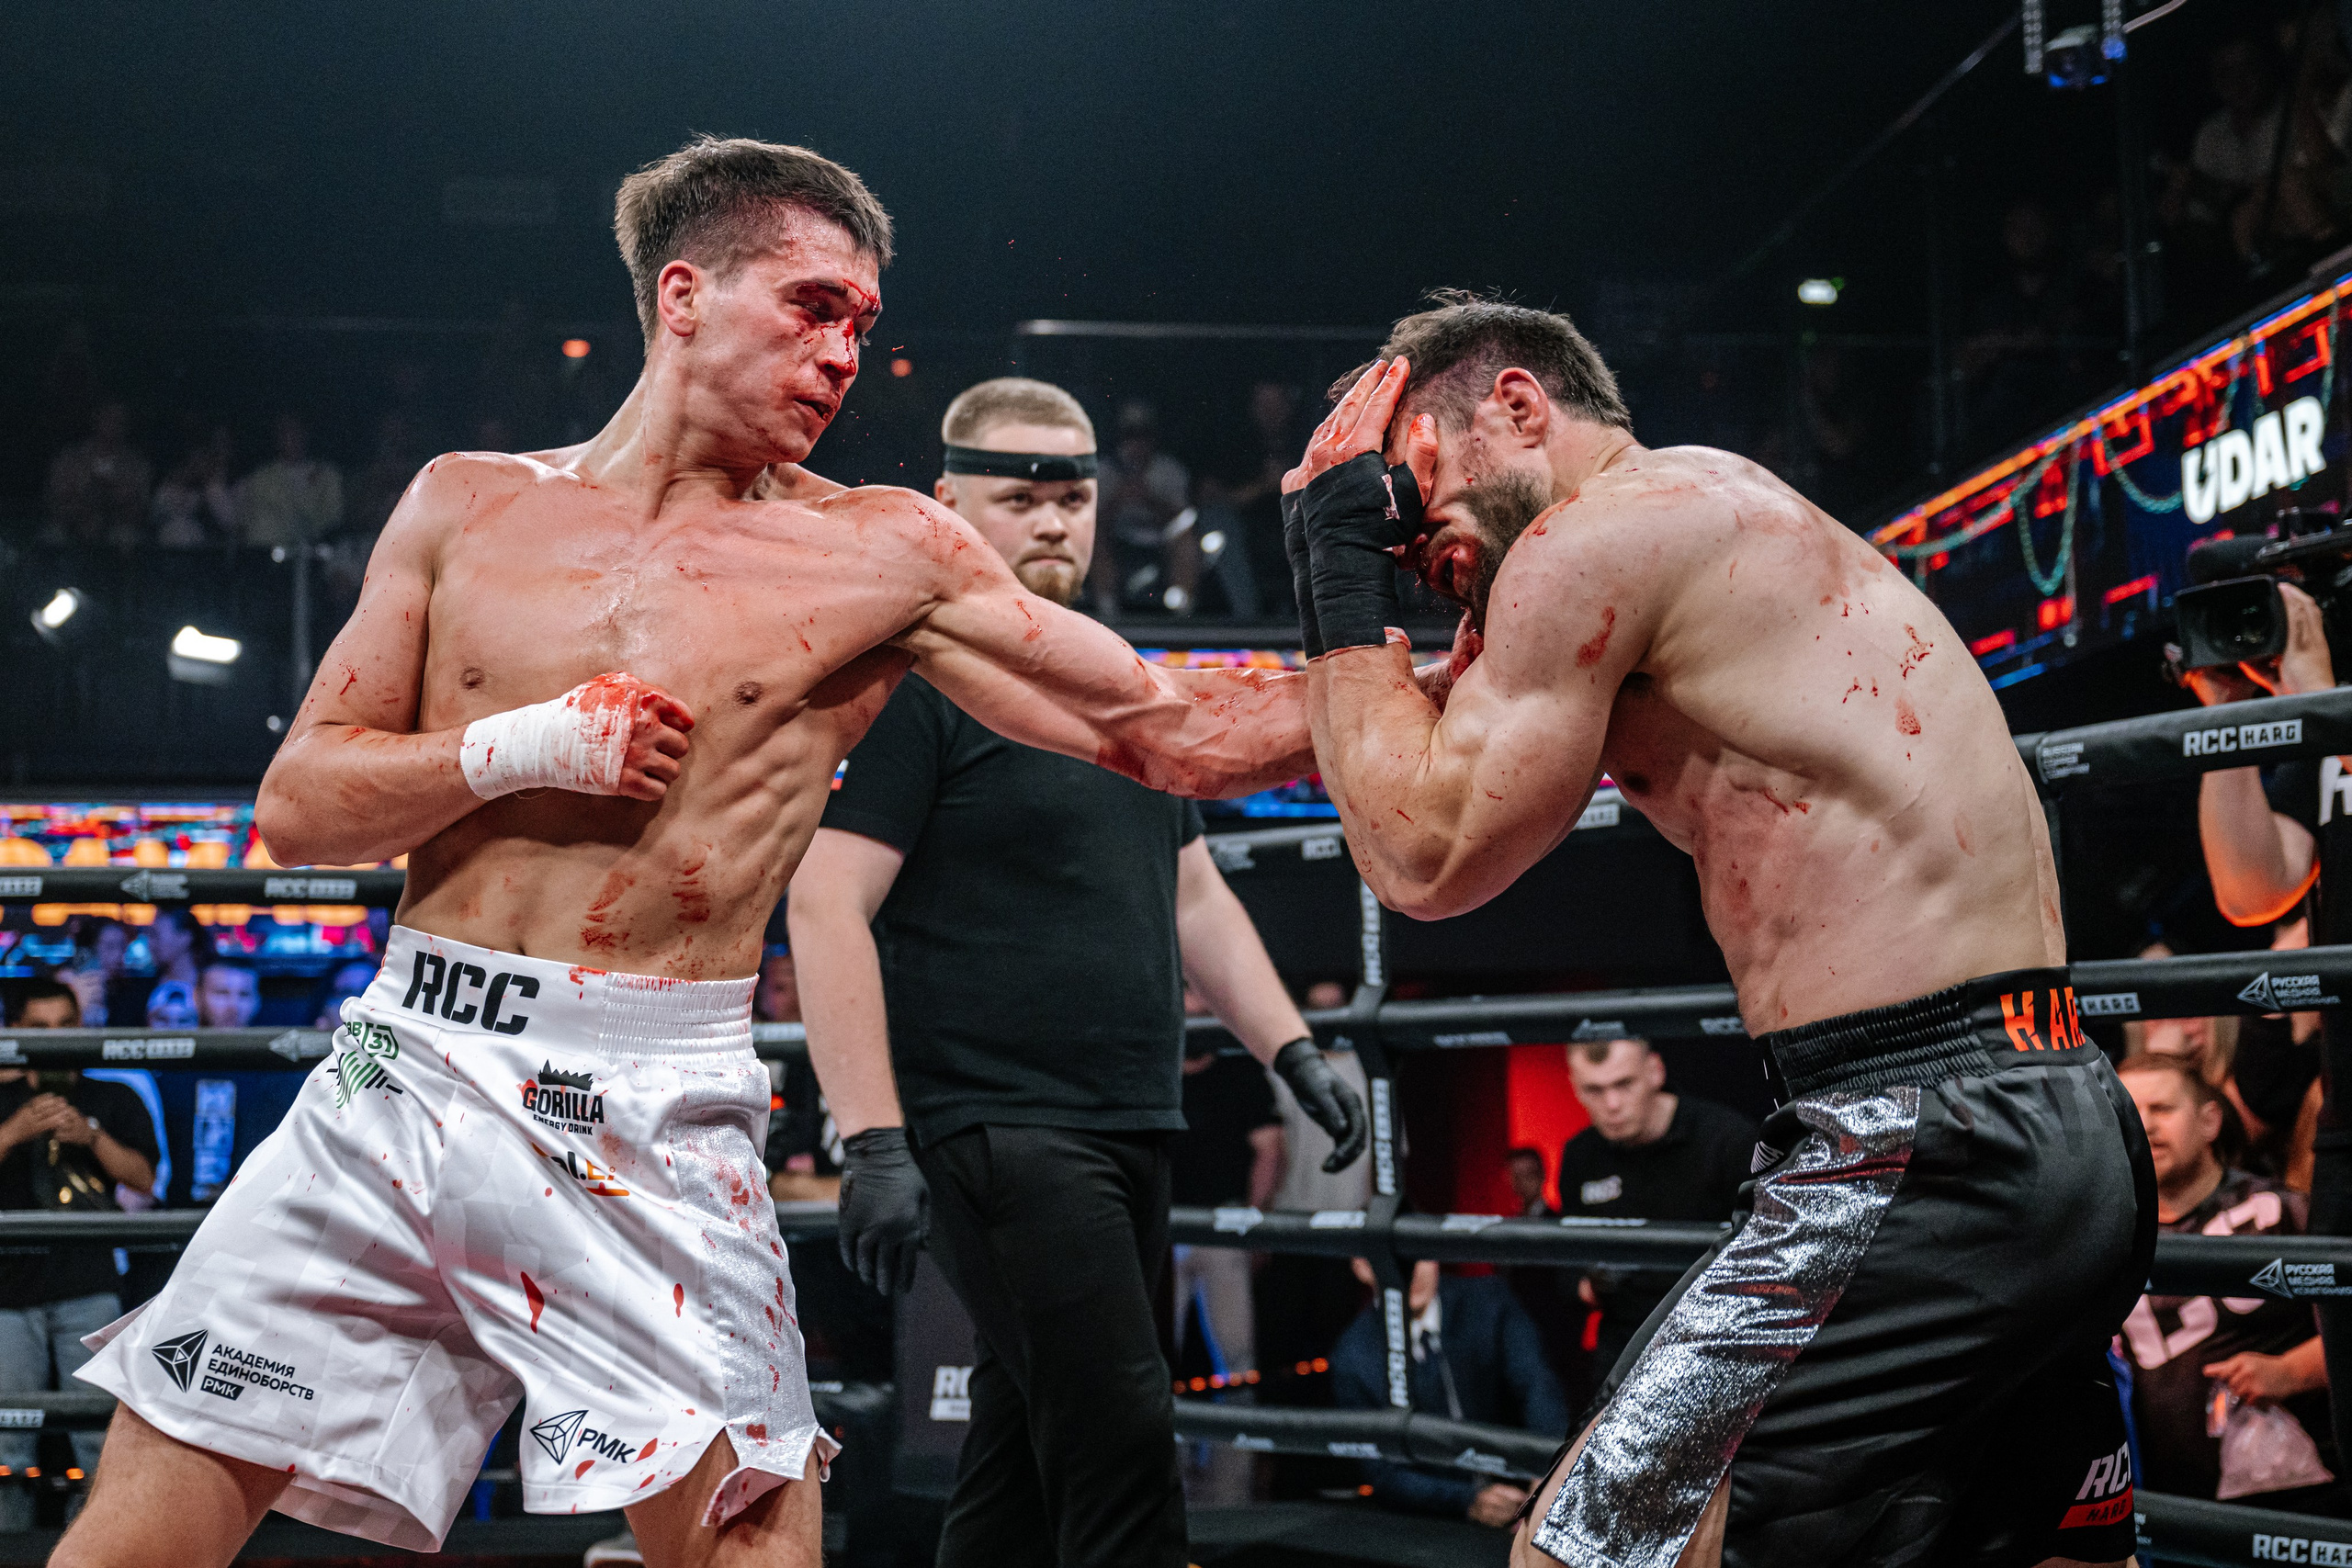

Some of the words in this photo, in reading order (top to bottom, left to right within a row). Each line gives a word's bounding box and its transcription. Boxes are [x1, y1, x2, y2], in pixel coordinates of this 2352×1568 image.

[2181, 395, 2327, 525] UDAR
[2183, 726, 2237, 757] RCC
[401, 950, 540, 1036] RCC
[368, 1032, 392, 1053] 31
[523, 1087, 605, 1123] GORILLA
[533, 1113, 567, 1132] ENERGY
[568, 1122, 594, 1135] DRINK
[211, 1343, 296, 1379] АКАДЕМИЯ
[202, 1378, 239, 1398] РМК
[207, 1358, 314, 1401] ЕДИНОБОРСТВ
[576, 1427, 637, 1463] РМК
[2252, 1533, 2310, 1564] RCC
